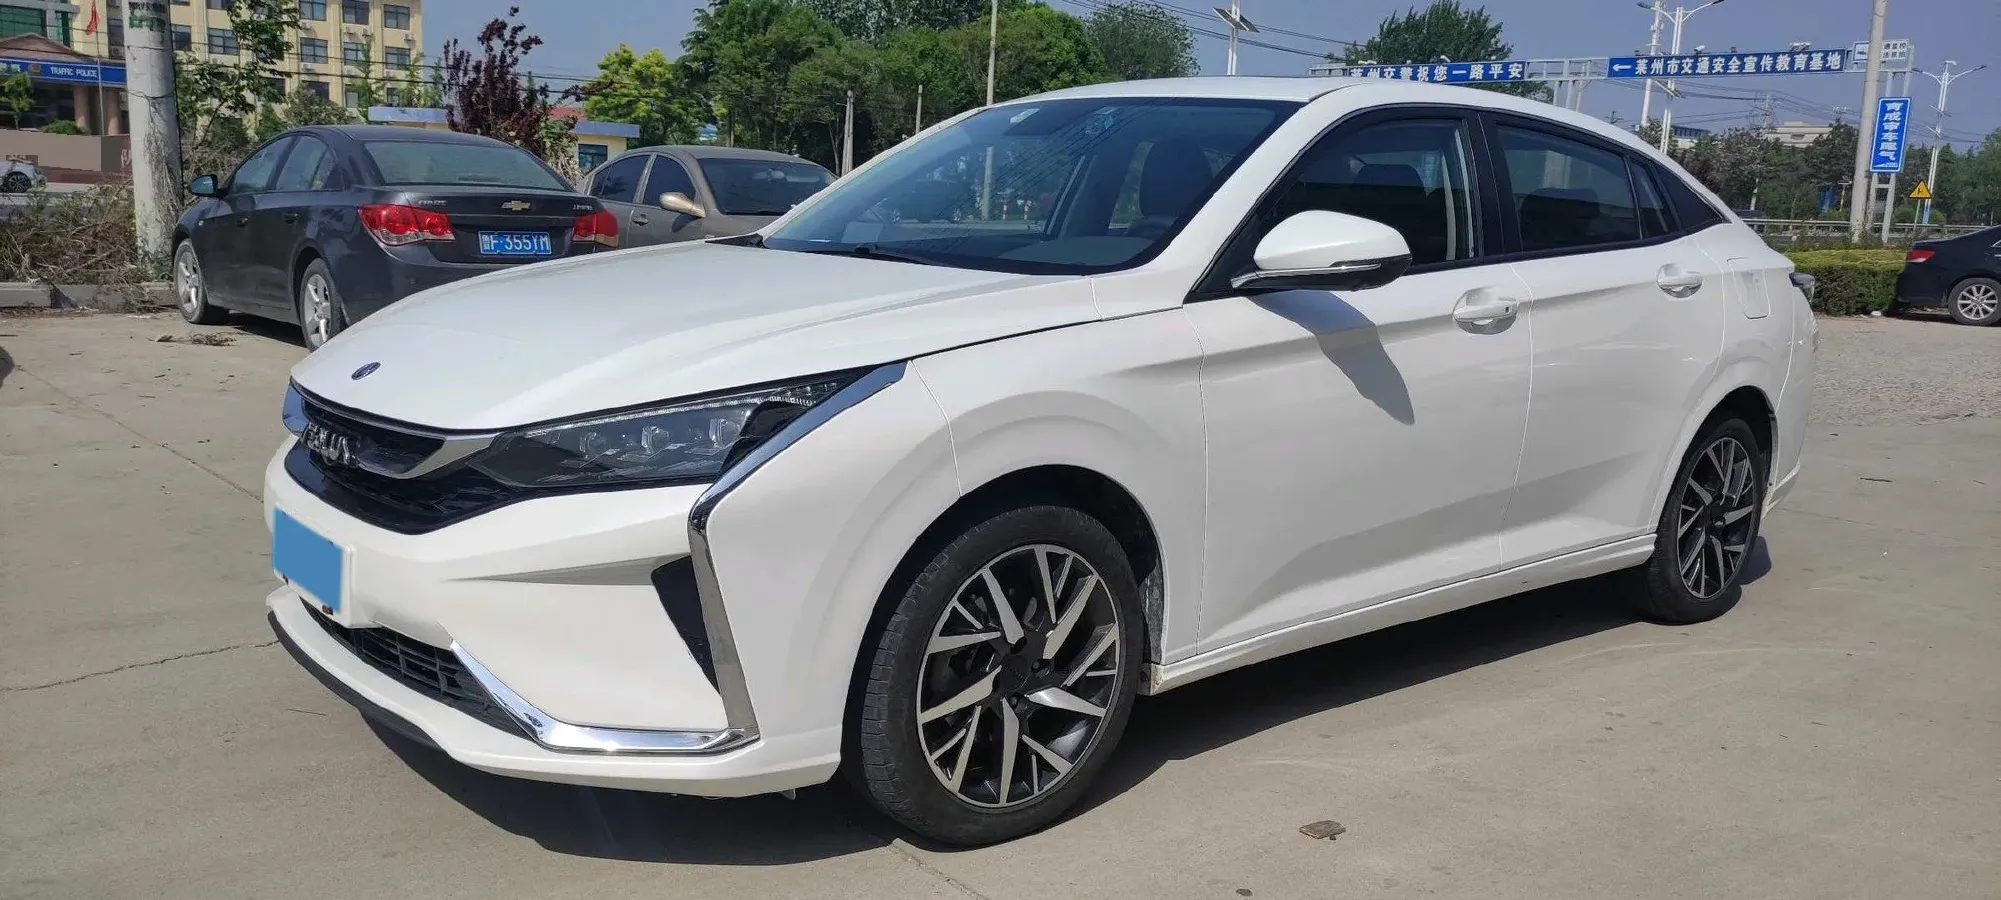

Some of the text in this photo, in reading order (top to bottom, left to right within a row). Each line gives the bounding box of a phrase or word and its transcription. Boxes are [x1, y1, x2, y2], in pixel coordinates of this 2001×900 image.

[51, 67, 97, 77] TRAFFIC POLICE
[1635, 53, 1841, 75] 莱州市交通安全宣传教育基地
